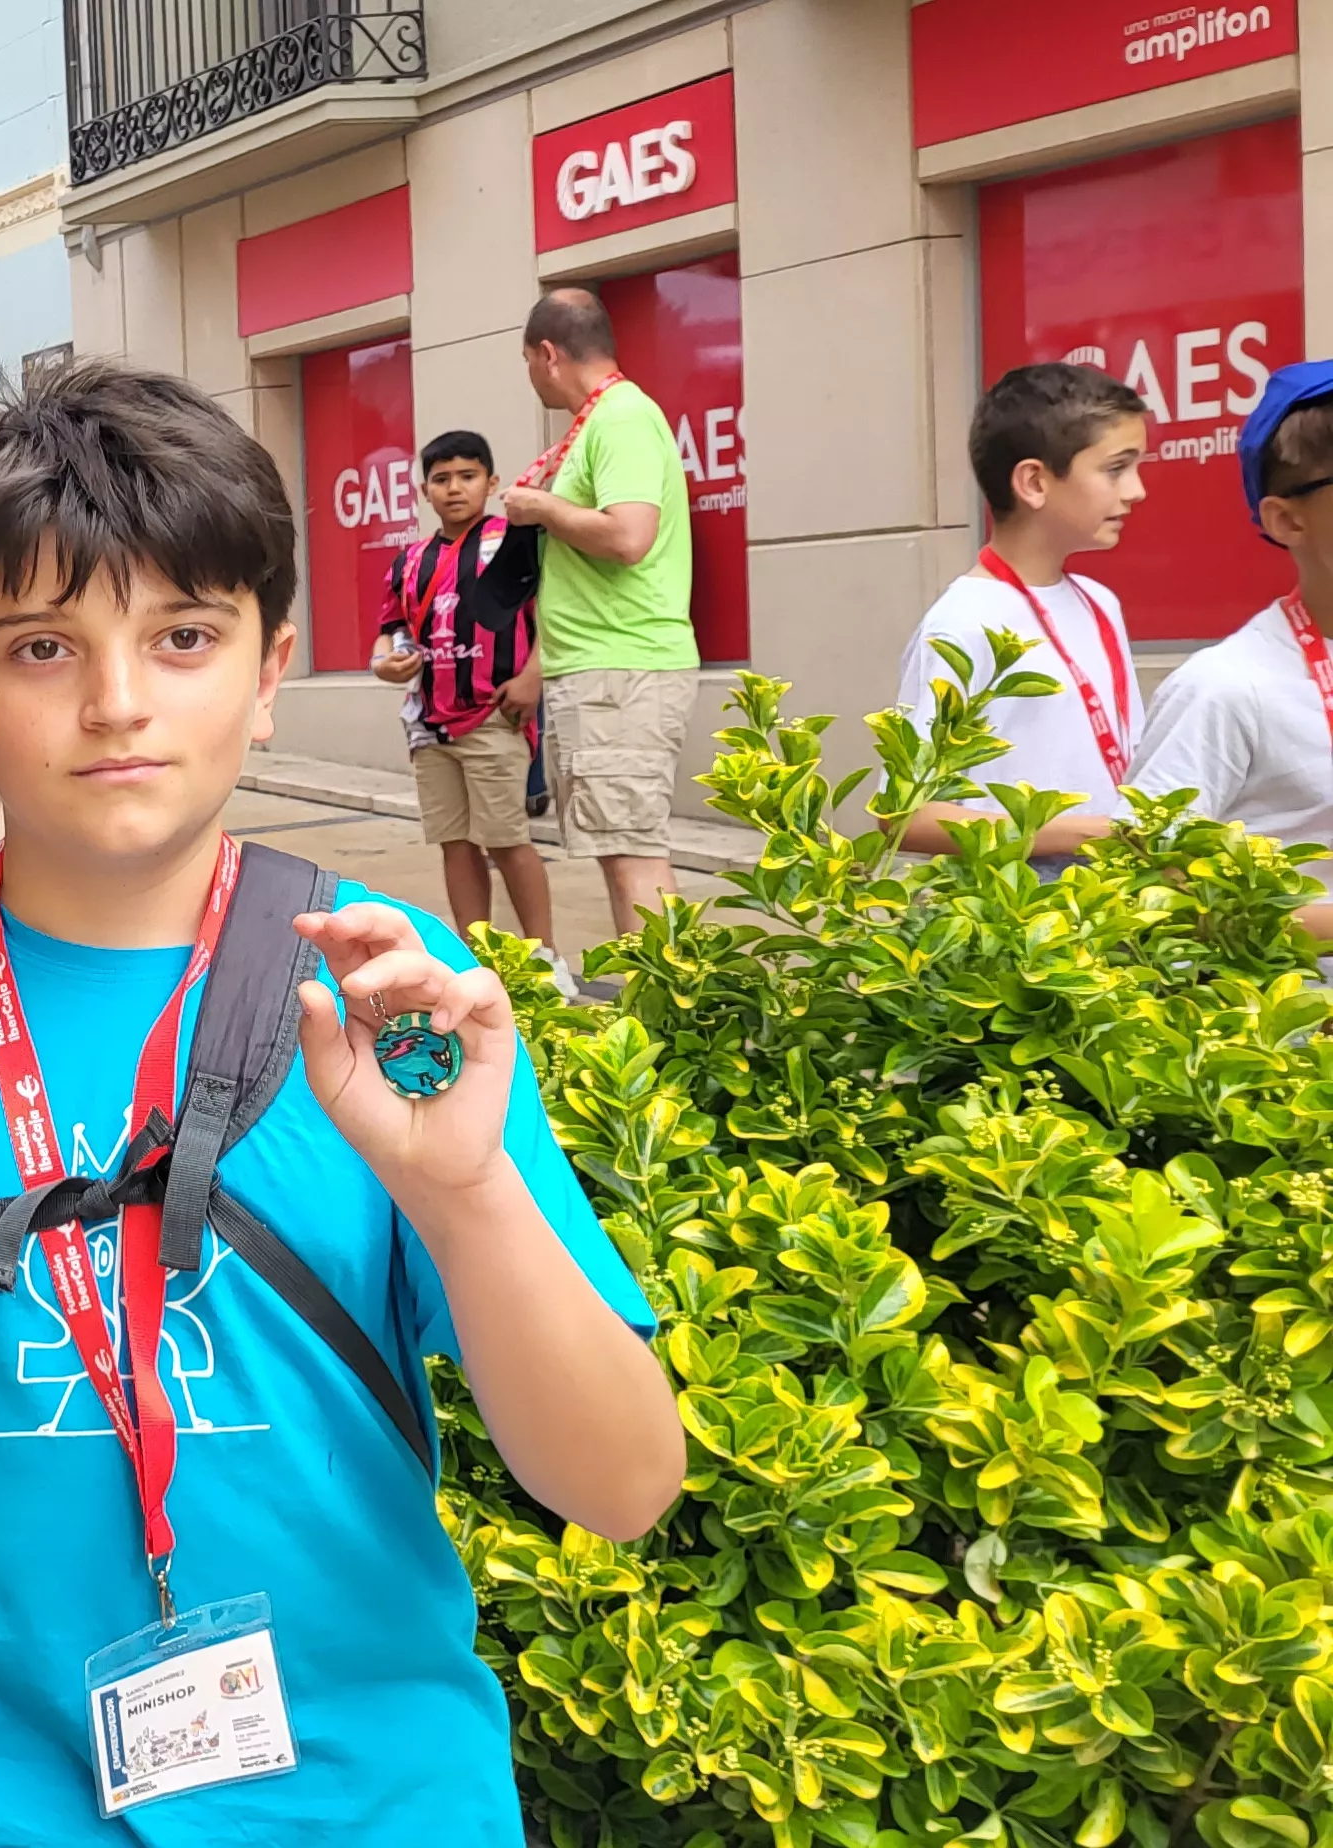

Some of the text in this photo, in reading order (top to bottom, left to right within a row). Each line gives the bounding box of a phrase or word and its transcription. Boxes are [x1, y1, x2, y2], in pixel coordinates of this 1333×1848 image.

[1125, 5, 1270, 65] amplifon
[556, 120, 697, 221] GAES
[1160, 427, 1238, 464] amplif
[14, 1116, 31, 1176] Fundación
[53, 1252, 77, 1316] Fundación
[127, 1685, 196, 1719] MINISHOP
